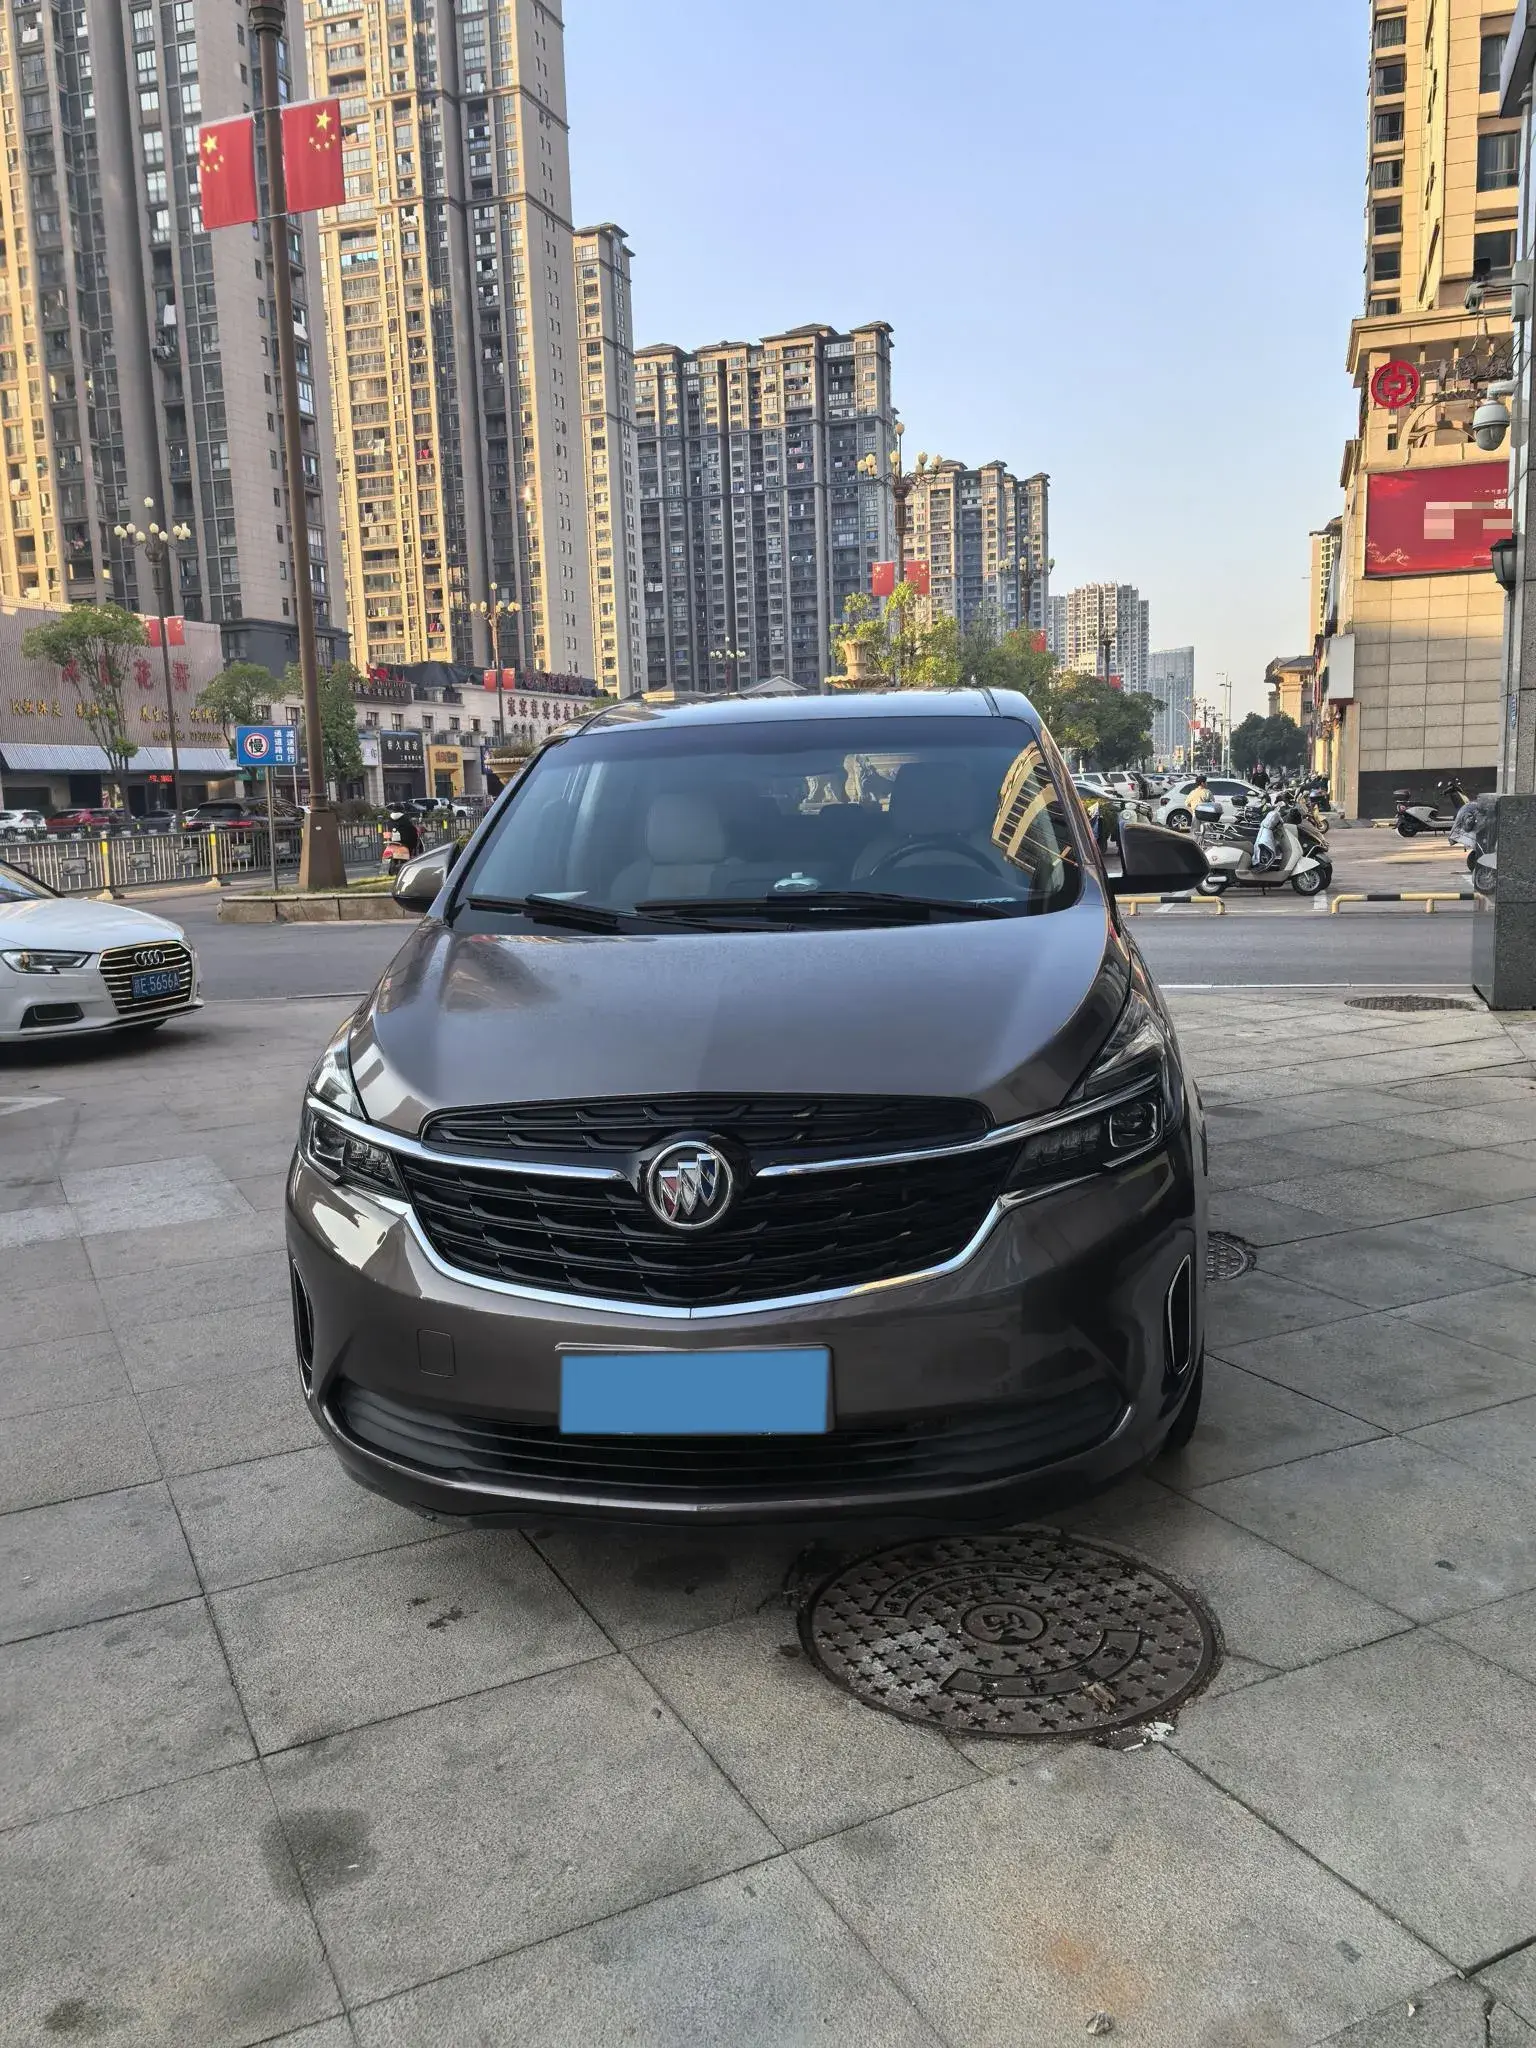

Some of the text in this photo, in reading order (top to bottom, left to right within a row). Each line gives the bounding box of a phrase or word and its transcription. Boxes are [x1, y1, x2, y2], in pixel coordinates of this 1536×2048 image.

[248, 738, 264, 754] 慢
[285, 730, 295, 763] 减速慢行
